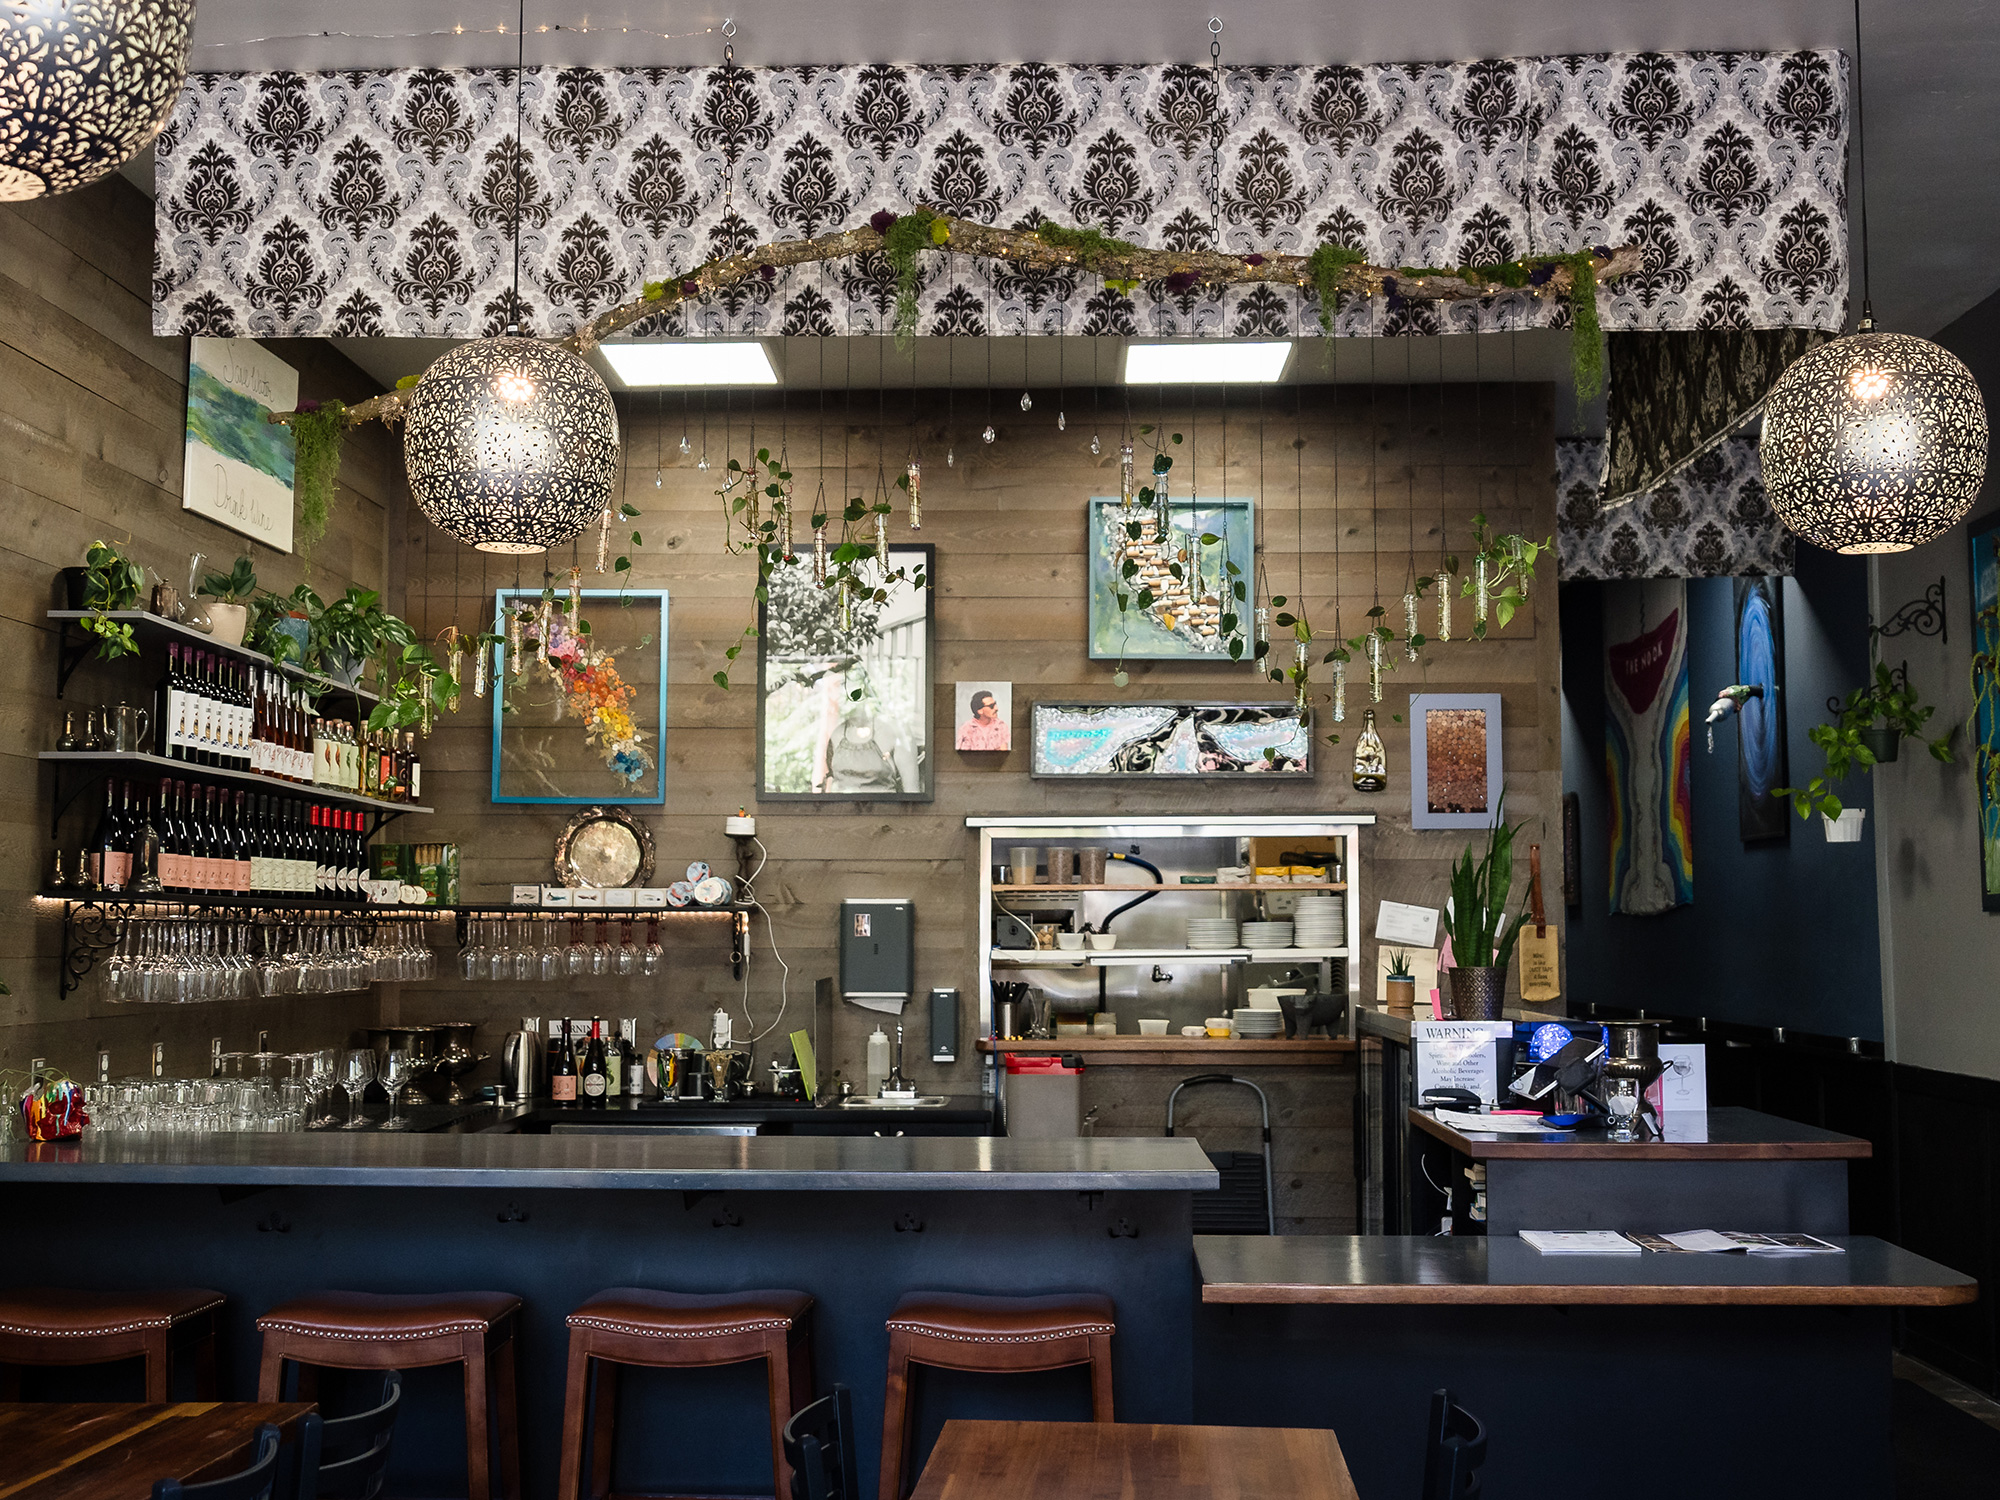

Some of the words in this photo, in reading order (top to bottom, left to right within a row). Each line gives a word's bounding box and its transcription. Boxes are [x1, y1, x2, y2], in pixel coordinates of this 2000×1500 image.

[223, 338, 250, 388] Save
[213, 463, 248, 521] Drink
[250, 498, 274, 531] Wine
[1625, 658, 1639, 675] THE
[1641, 640, 1663, 670] NOOK
[556, 1025, 603, 1034] WRNIN
